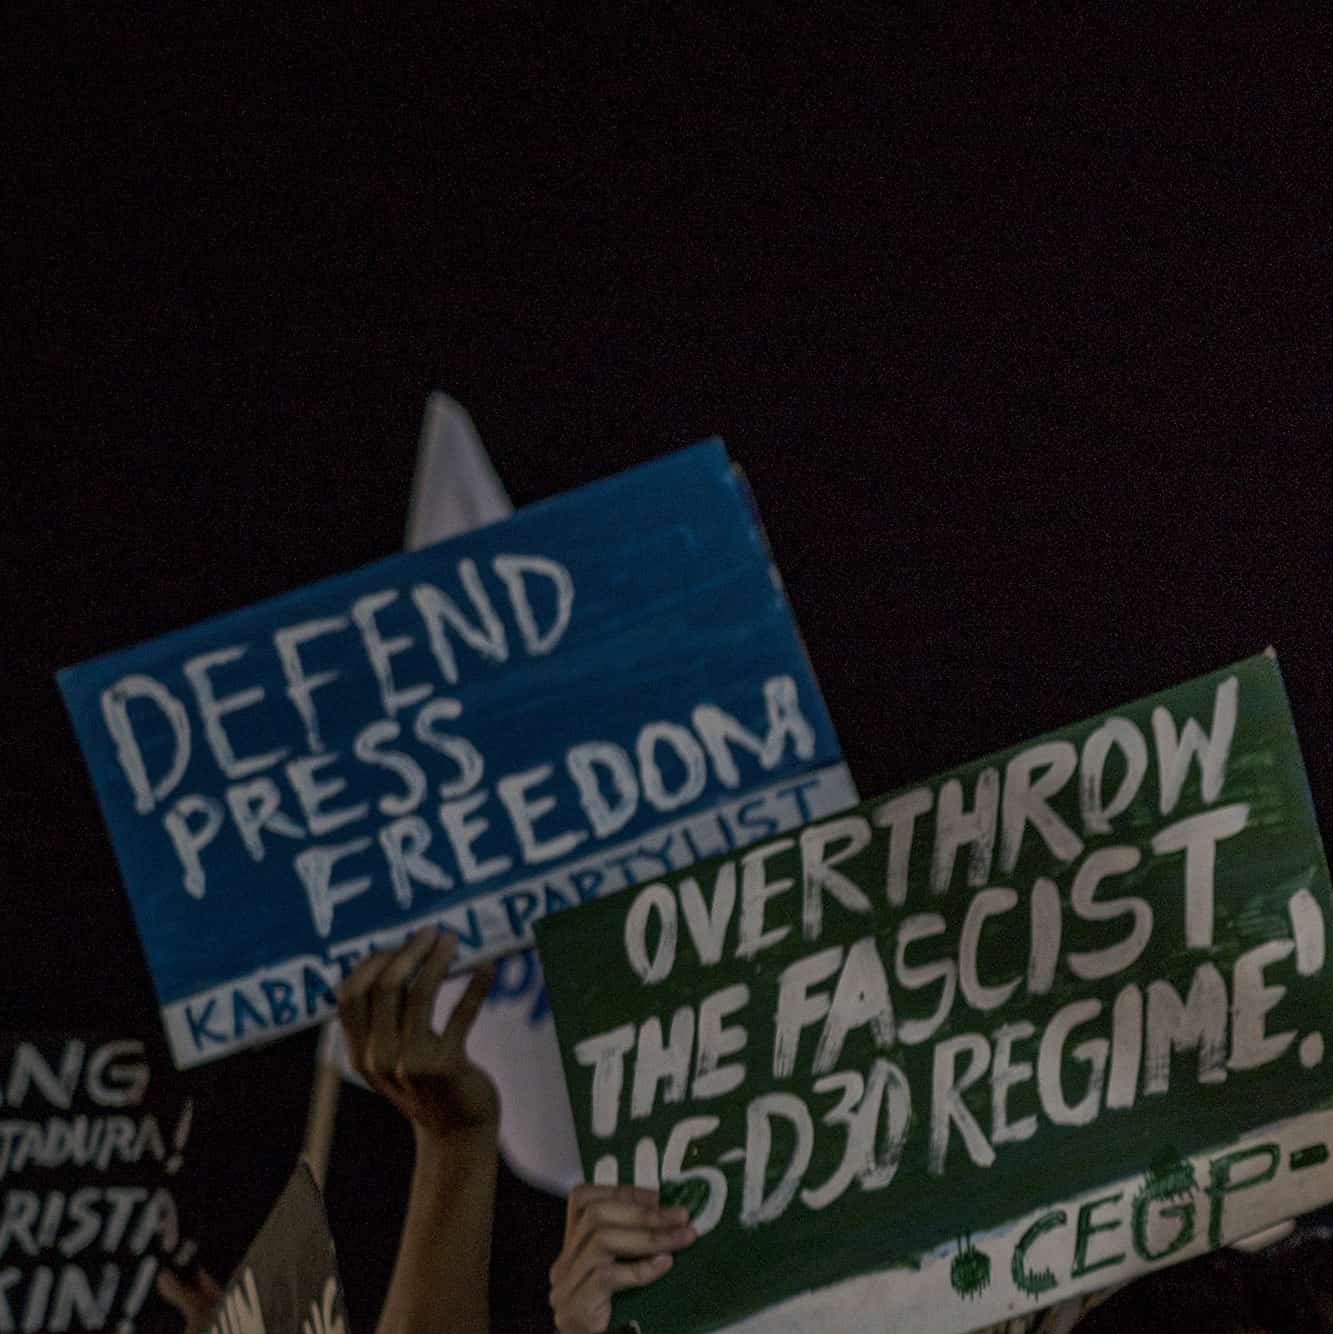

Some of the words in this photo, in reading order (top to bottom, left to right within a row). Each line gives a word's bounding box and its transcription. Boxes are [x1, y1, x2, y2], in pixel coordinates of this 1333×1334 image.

[102, 554, 575, 812] DEFEND
[163, 696, 486, 900] PRESS
[294, 675, 815, 938] FREEDOM
[624, 676, 1238, 985] OVERTHROW
[0, 1037, 152, 1110] NG
[574, 985, 750, 1138] THE
[772, 803, 1250, 1090] FASCIST
[927, 890, 1326, 1175] REGIME!
